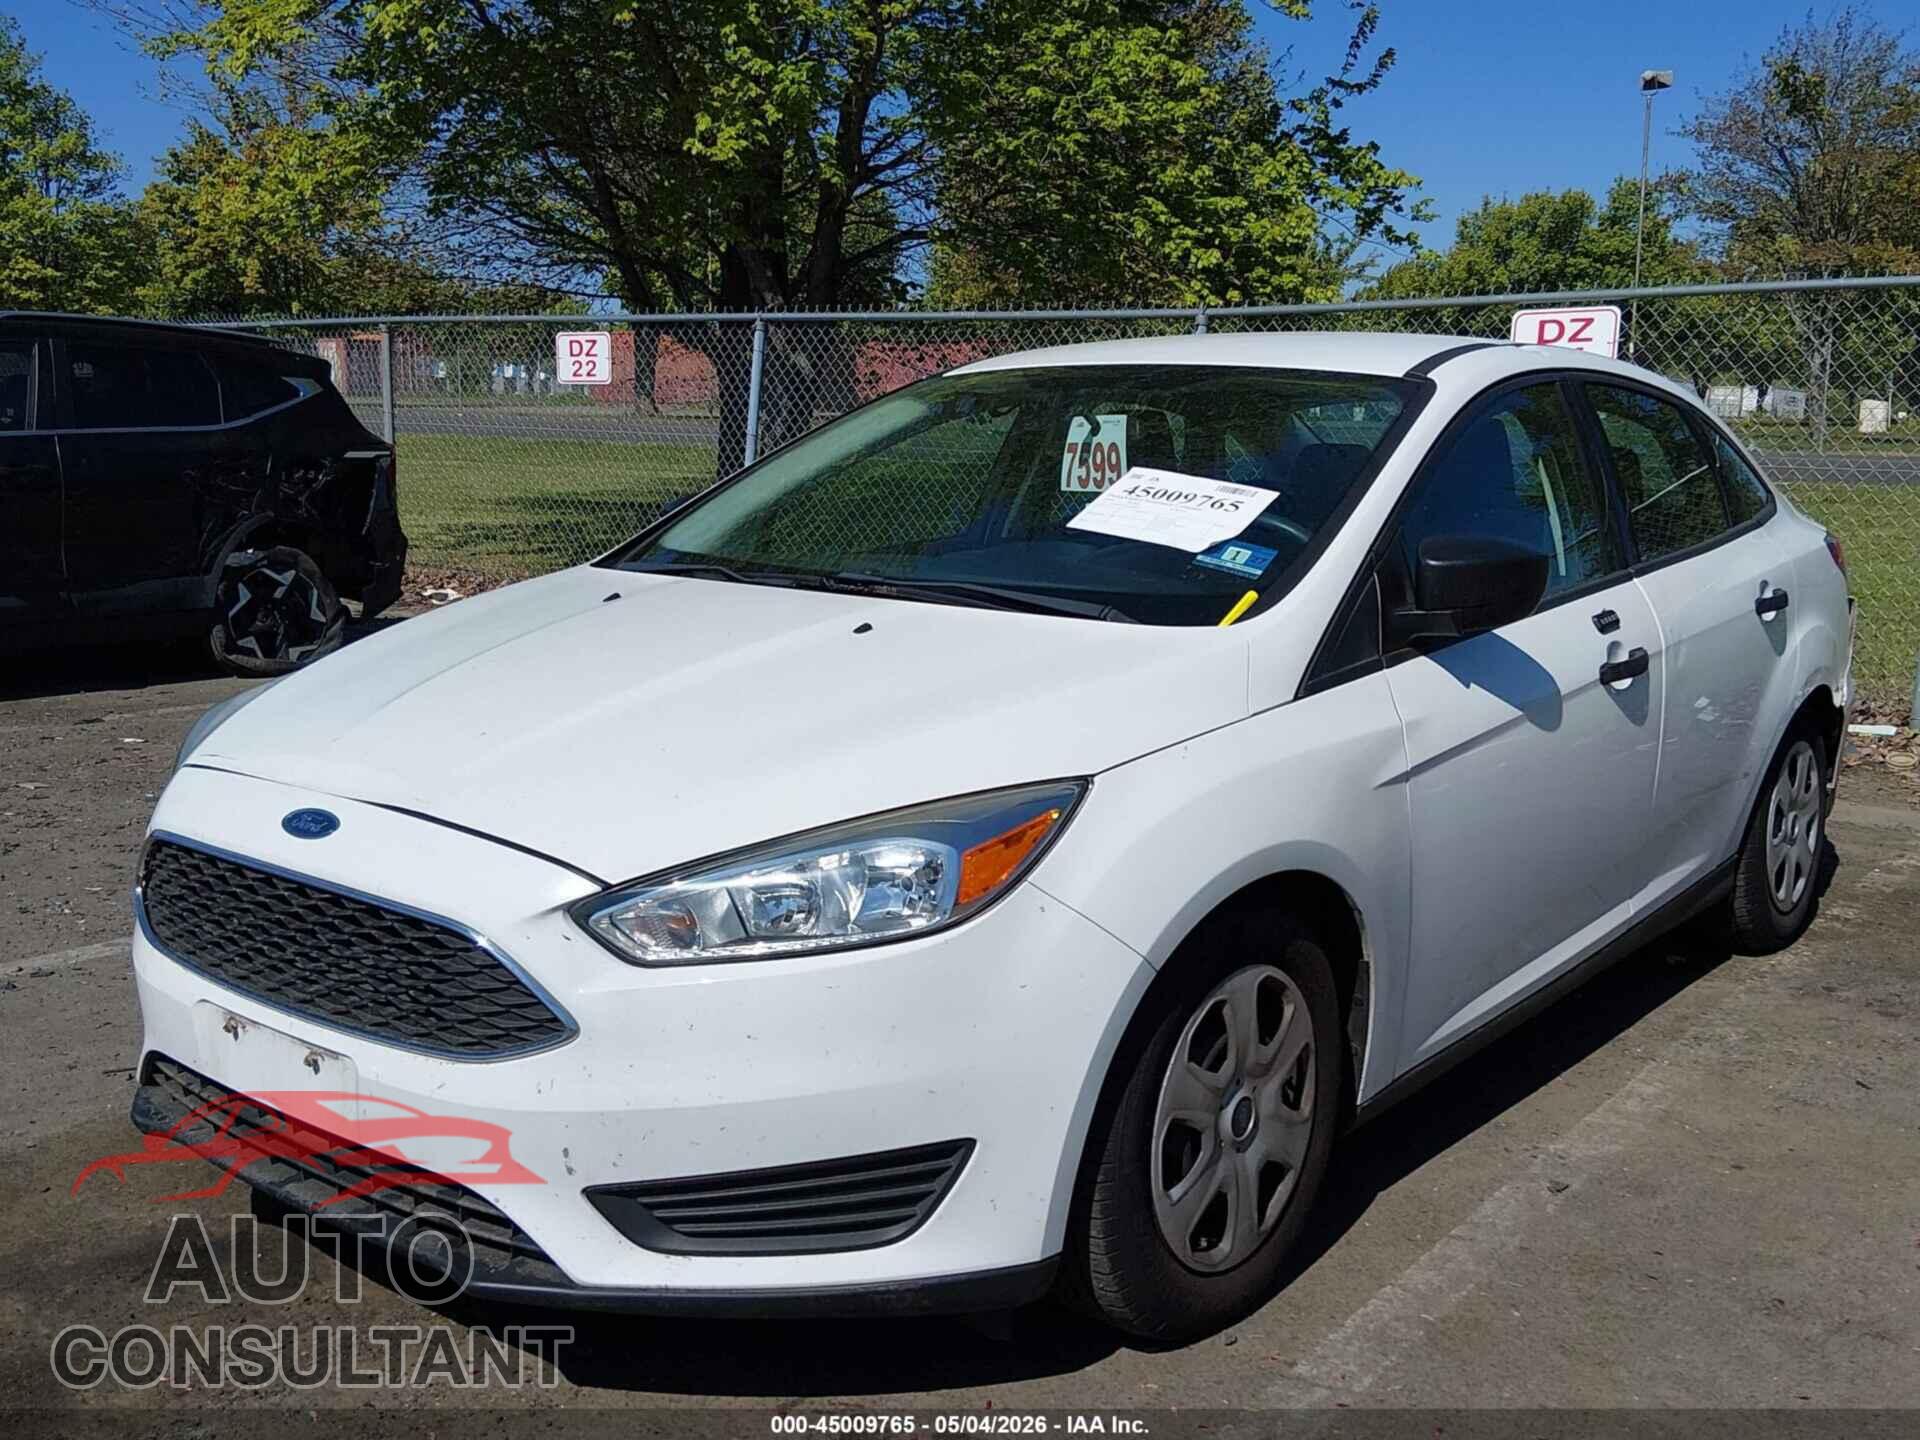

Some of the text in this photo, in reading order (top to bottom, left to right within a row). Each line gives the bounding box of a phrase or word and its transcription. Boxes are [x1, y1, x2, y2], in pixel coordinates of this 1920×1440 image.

[1537, 317, 1595, 345] DZ
[568, 339, 598, 358] DZ
[572, 360, 598, 378] 22
[1066, 442, 1122, 490] 7599
[1123, 484, 1245, 514] 45009765
